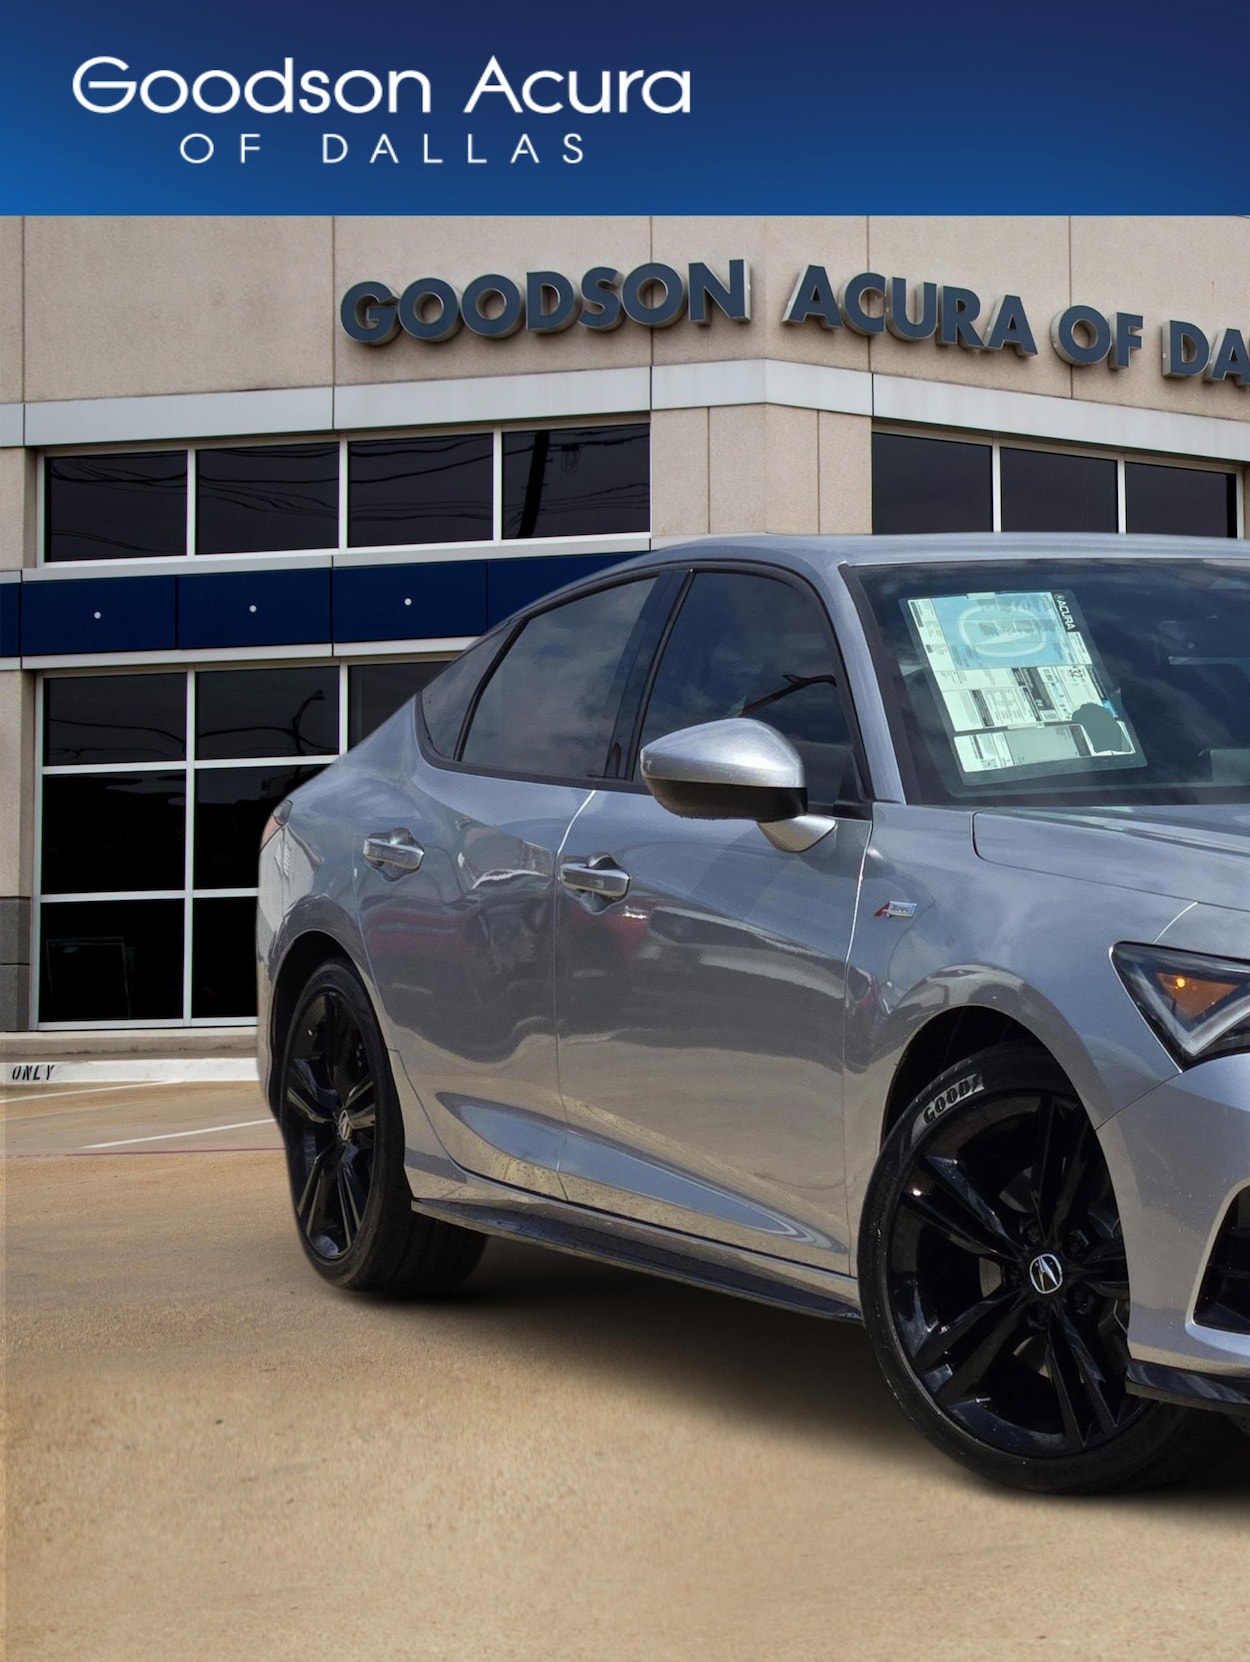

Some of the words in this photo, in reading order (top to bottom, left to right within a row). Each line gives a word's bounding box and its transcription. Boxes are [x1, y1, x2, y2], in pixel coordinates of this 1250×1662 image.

[340, 259, 751, 345] GOODSON
[782, 264, 1038, 357] ACURA
[1051, 304, 1144, 370] OF
[1057, 599, 1077, 630] ACURA
[12, 1064, 55, 1081] ONLY
